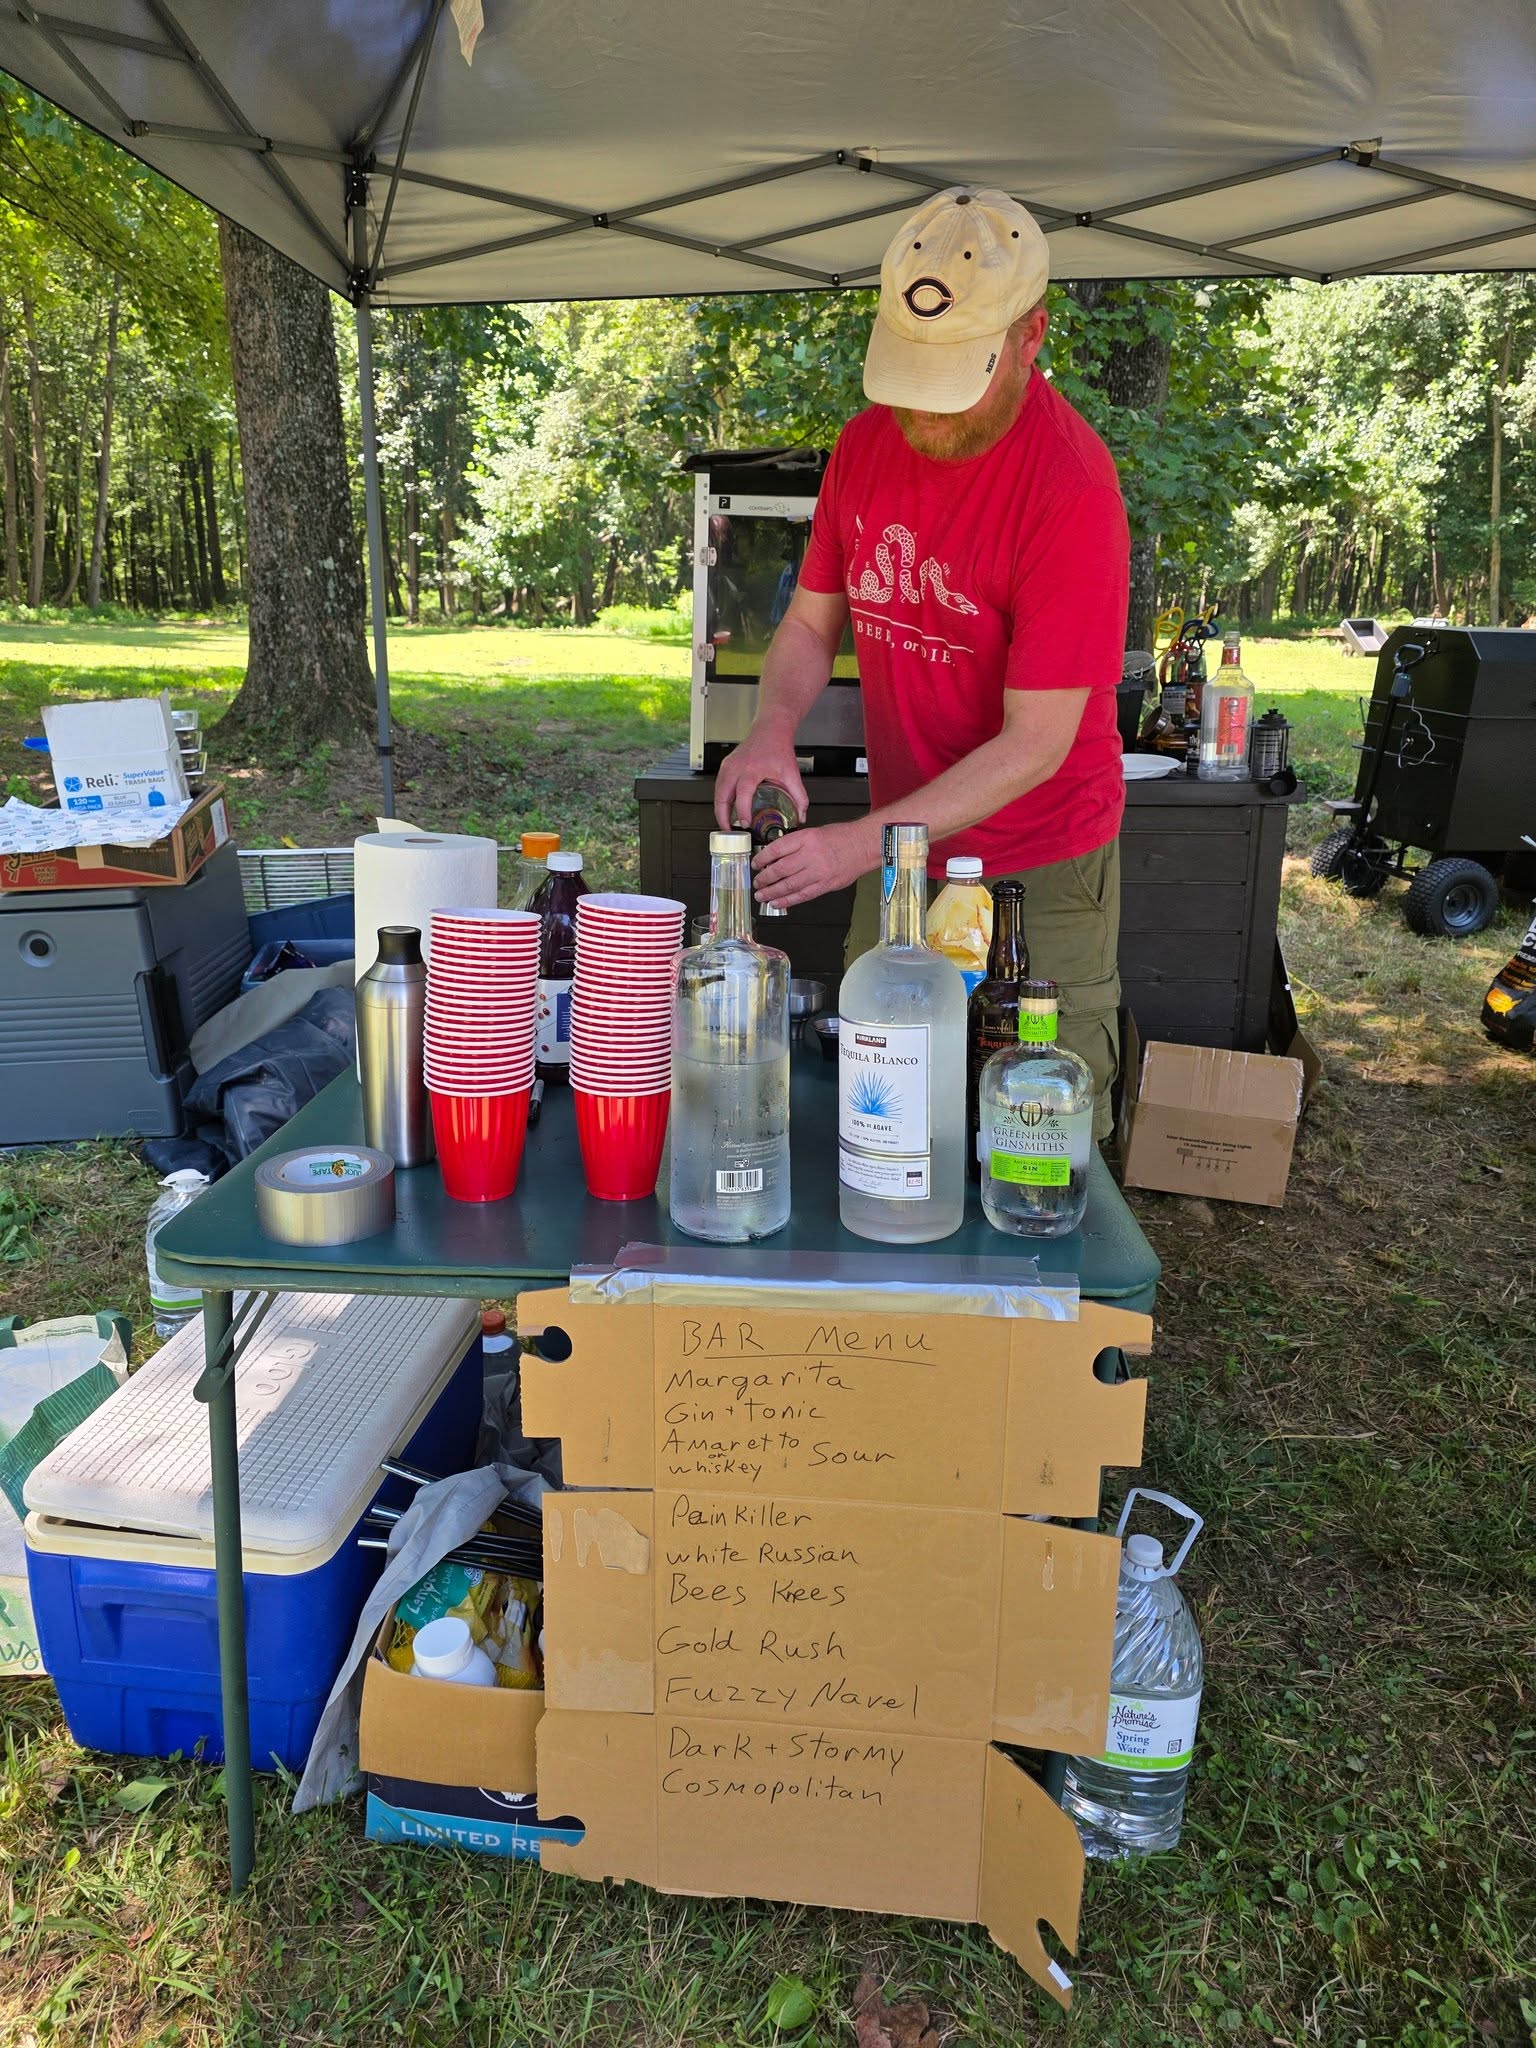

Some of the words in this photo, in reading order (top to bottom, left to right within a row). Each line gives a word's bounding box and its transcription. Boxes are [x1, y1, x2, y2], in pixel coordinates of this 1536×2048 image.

[985, 352, 996, 374] REDS
[86, 773, 118, 788] Reli.
[148, 776, 166, 784] BAGS
[856, 1034, 886, 1044] KIRKLAND
[873, 1052, 919, 1066] BLANCO
[851, 1119, 866, 1128] 100%
[993, 1126, 1068, 1140] GREENHOOK
[996, 1137, 1065, 1151] GINSMITHS
[311, 1168, 333, 1176] TAPE
[683, 1320, 764, 1356] BAR
[806, 1326, 935, 1353] Menu
[665, 1361, 855, 1400] Margarita
[664, 1402, 714, 1424] Gin
[808, 1441, 896, 1466] Sour
[666, 1542, 748, 1565] white
[759, 1542, 859, 1565] Russian
[670, 1573, 746, 1606] Bees
[657, 1625, 741, 1655] Gold
[759, 1630, 846, 1663] Rush
[665, 1677, 797, 1712] Fuzzy
[807, 1678, 918, 1720] Navel
[1112, 1715, 1160, 1729] Promise
[1115, 1705, 1157, 1722] Nature's
[1116, 1731, 1150, 1746] Spring
[1117, 1742, 1146, 1754] Water
[670, 1726, 753, 1760] Dark
[788, 1731, 904, 1776] Stormy
[661, 1768, 882, 1806] Cosmopolitan
[401, 1820, 500, 1847] LIMITED
